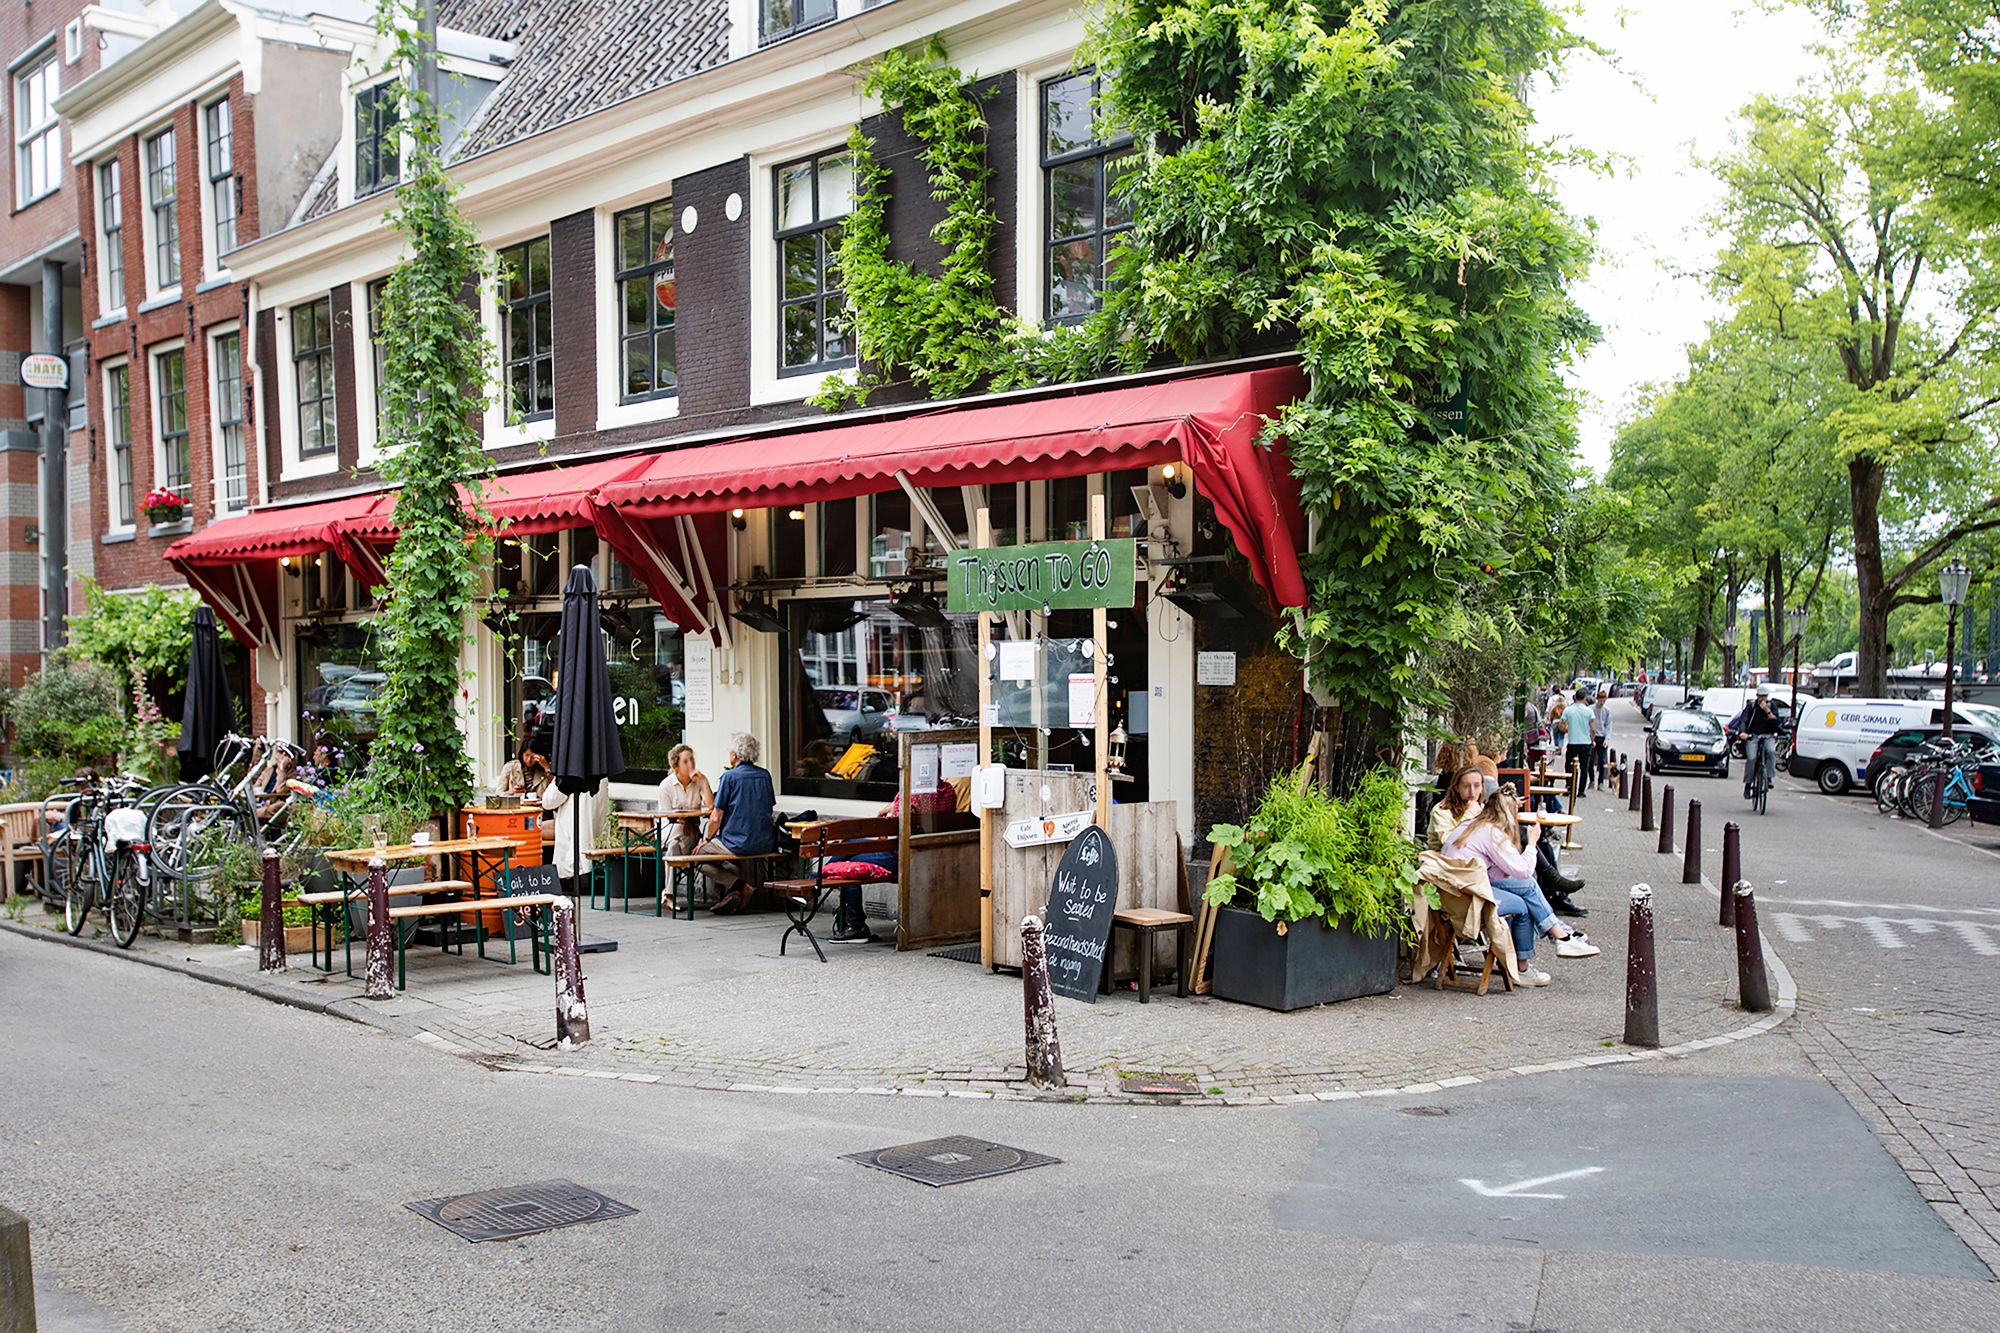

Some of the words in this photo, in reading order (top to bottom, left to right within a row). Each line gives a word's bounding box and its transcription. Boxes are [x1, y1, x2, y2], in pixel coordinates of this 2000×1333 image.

[956, 556, 1040, 606] Thijssen
[1044, 553, 1073, 593] TO
[1079, 547, 1112, 590] GO
[528, 874, 539, 887] to
[541, 873, 552, 886] be
[1080, 879, 1092, 900] to
[1094, 884, 1107, 904] be
[1063, 899, 1096, 920] Seated
[1048, 952, 1058, 967] de
